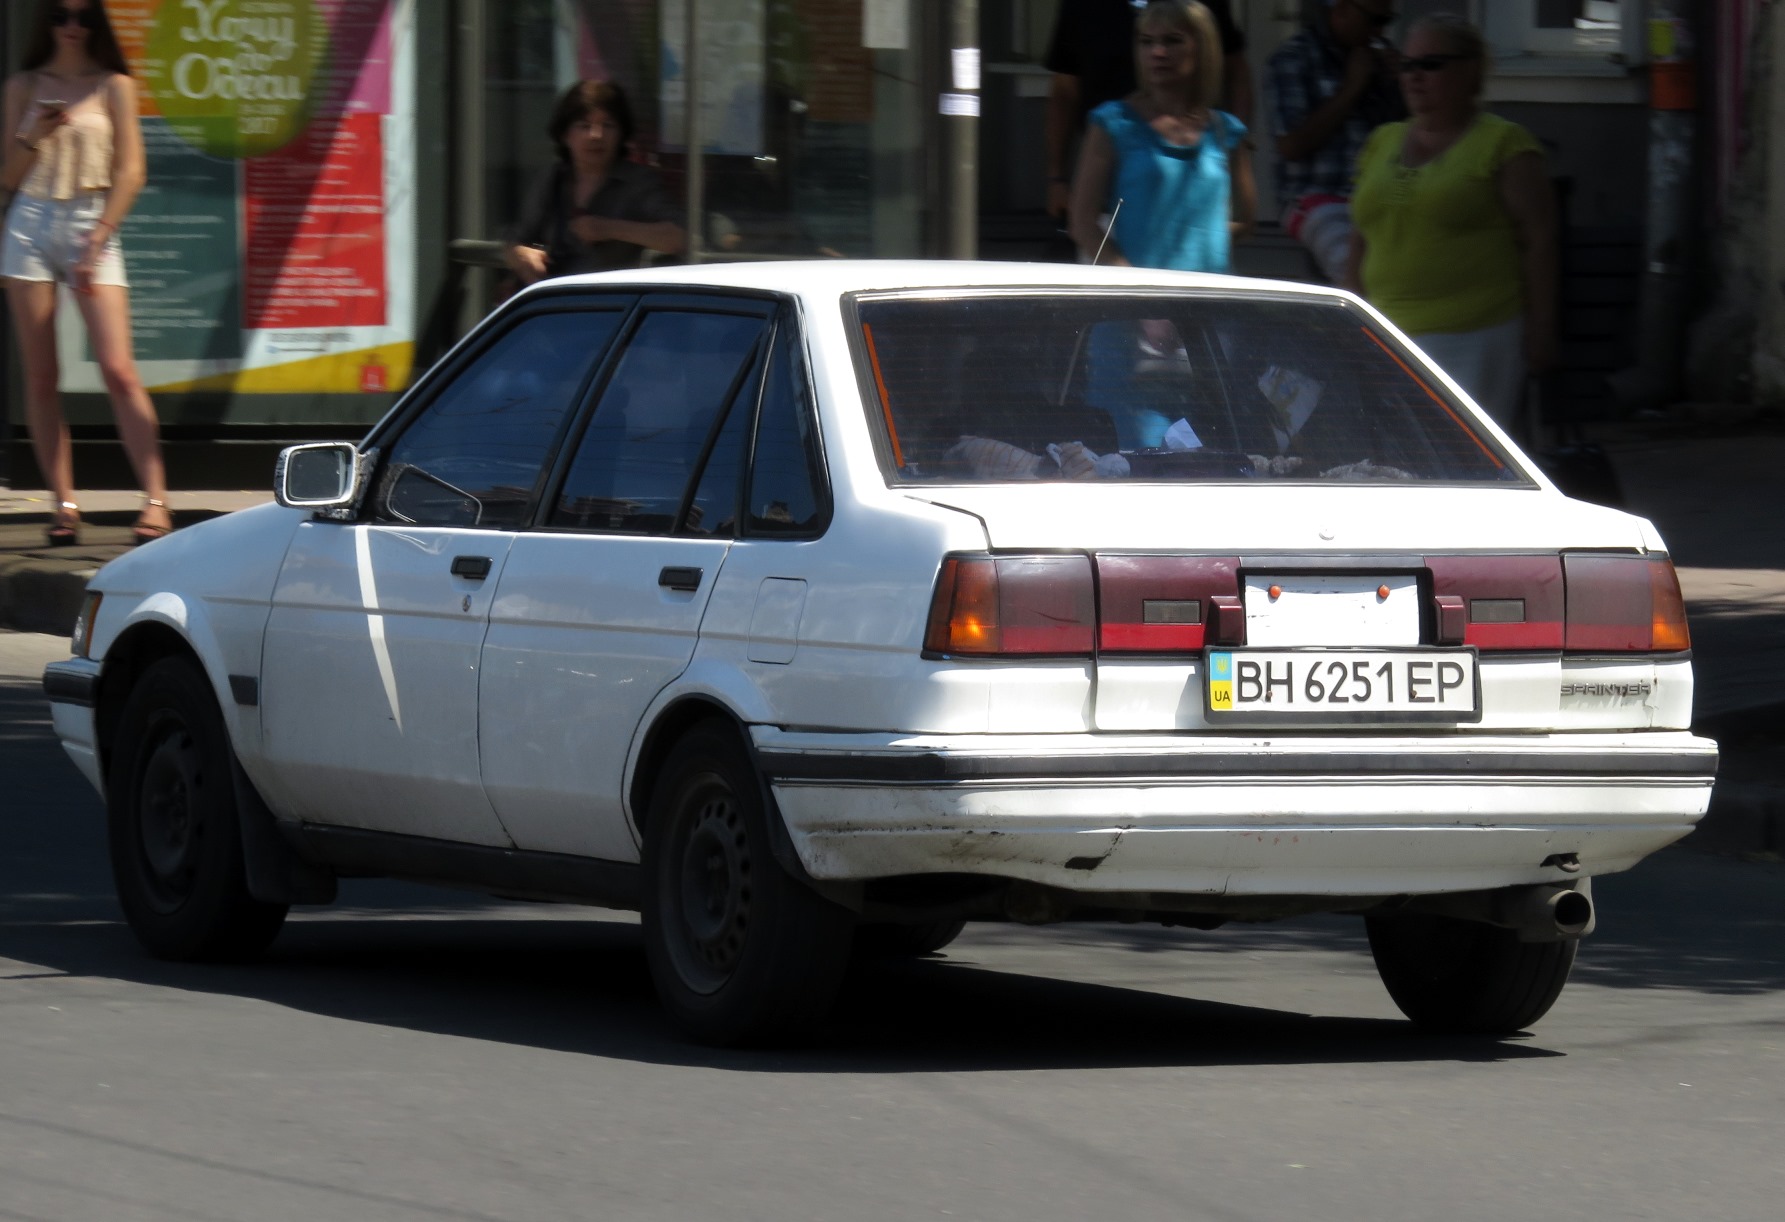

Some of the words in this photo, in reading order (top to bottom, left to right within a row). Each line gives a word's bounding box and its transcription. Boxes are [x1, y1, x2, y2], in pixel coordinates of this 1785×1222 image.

[1237, 660, 1293, 703] BH
[1304, 660, 1394, 703] 6251
[1407, 660, 1465, 703] EP
[1214, 690, 1231, 702] UA
[1560, 683, 1651, 697] SPRINTER
